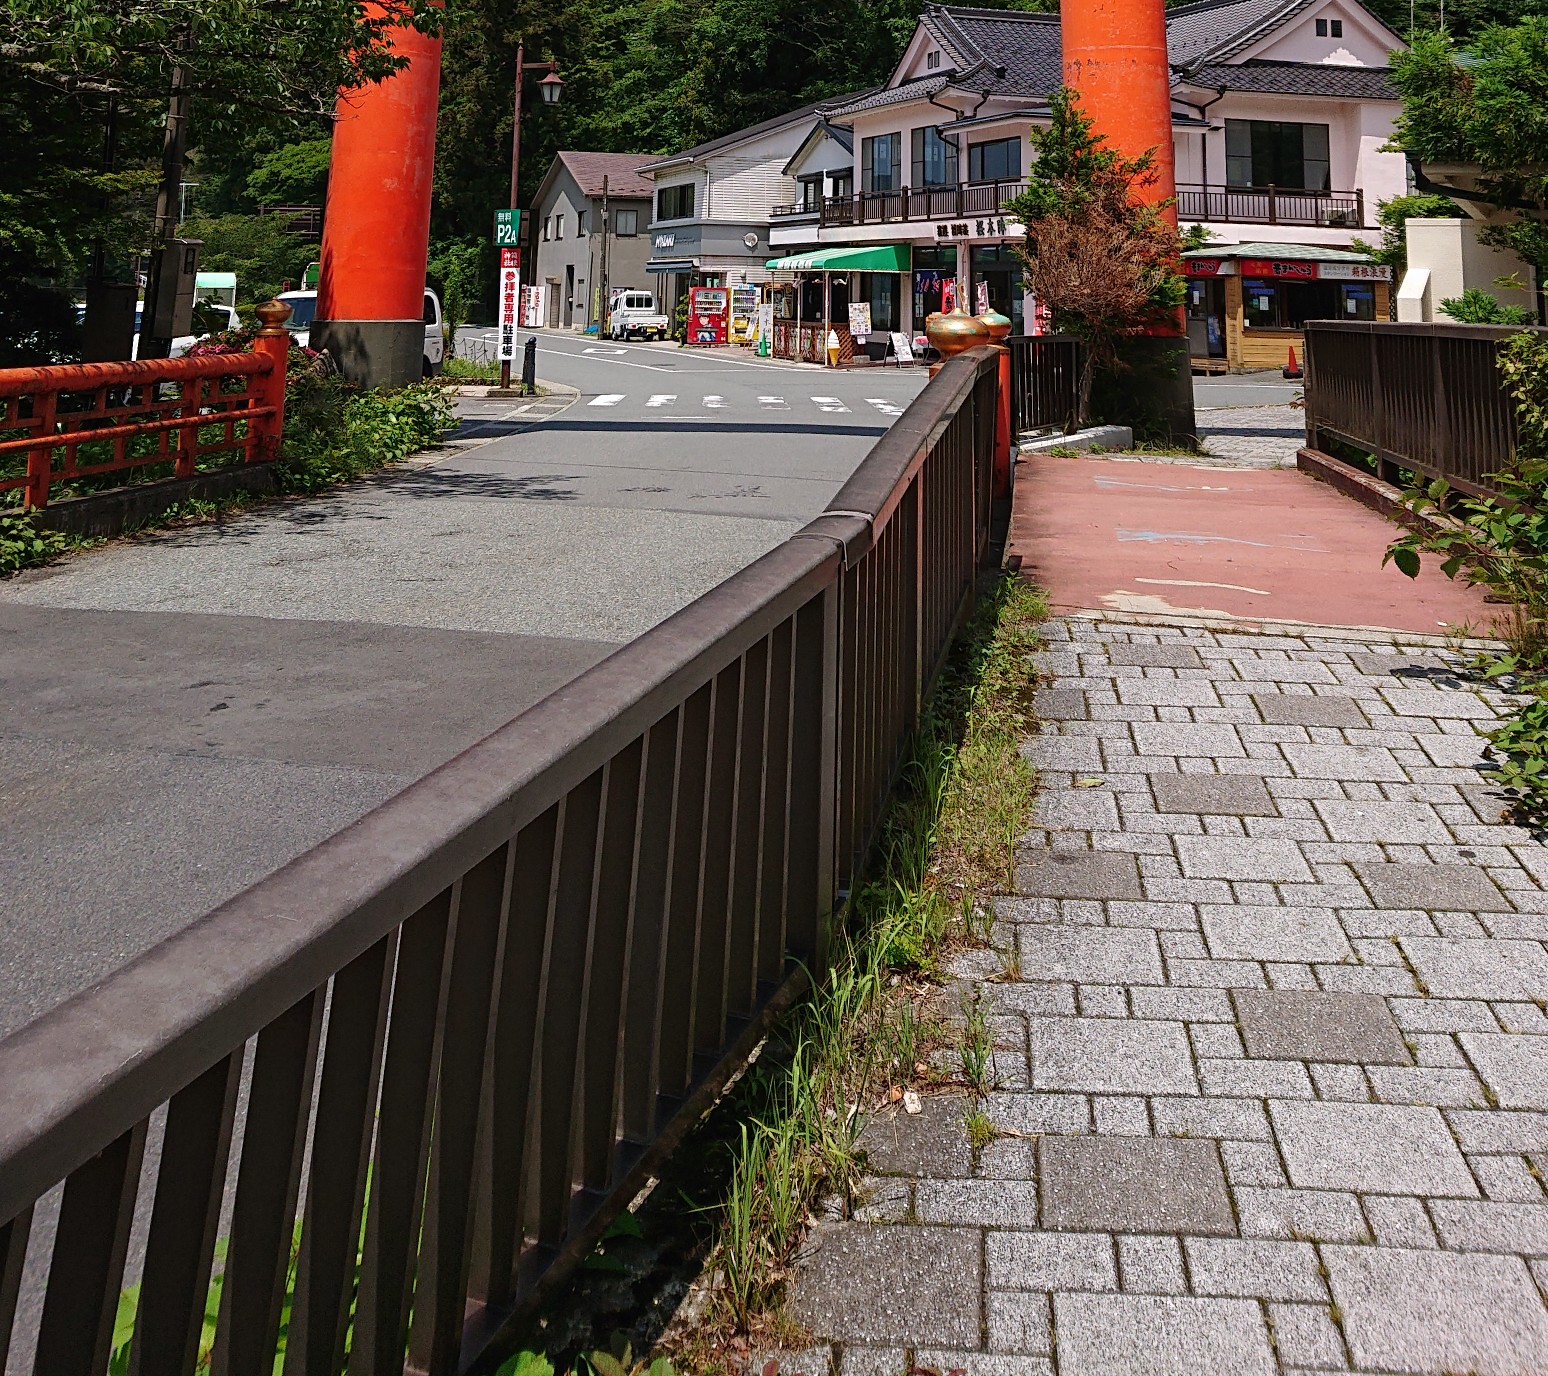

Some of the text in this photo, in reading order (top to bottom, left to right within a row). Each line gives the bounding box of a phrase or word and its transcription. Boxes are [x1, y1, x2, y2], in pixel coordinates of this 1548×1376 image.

[498, 212, 511, 222] 無料
[497, 224, 516, 243] P2A
[1352, 266, 1388, 279] 箱根浪漫
